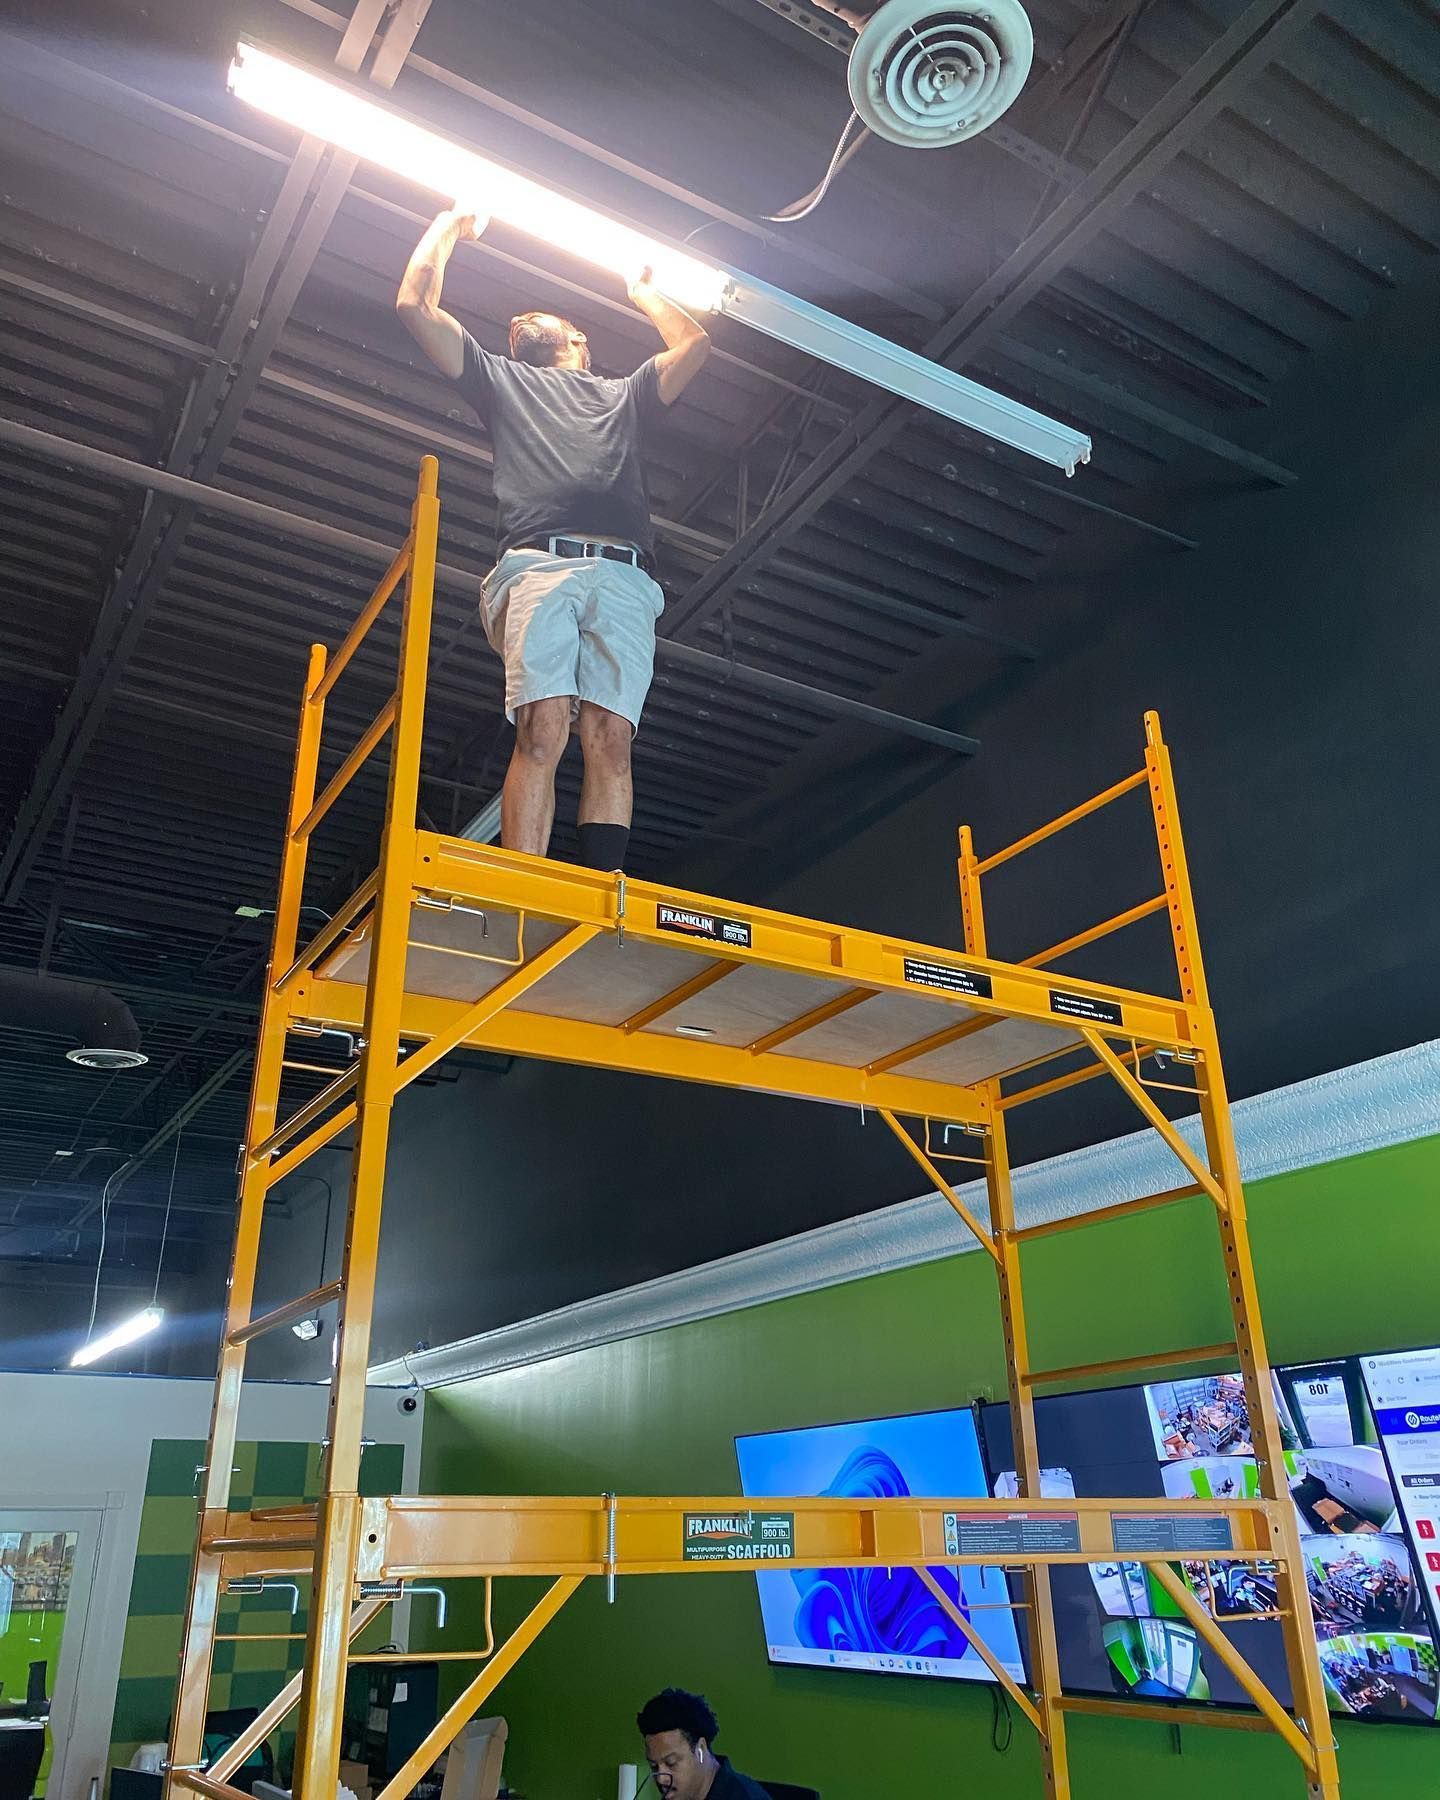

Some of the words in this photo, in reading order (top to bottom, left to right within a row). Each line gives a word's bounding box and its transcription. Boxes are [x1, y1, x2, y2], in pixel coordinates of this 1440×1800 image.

[661, 909, 713, 932] FRANKLIN
[688, 1519, 749, 1536] FRANKLIN
[763, 1529, 777, 1537] 900
[778, 1529, 788, 1537] lb.
[727, 1544, 791, 1559] SCAFFOLD
